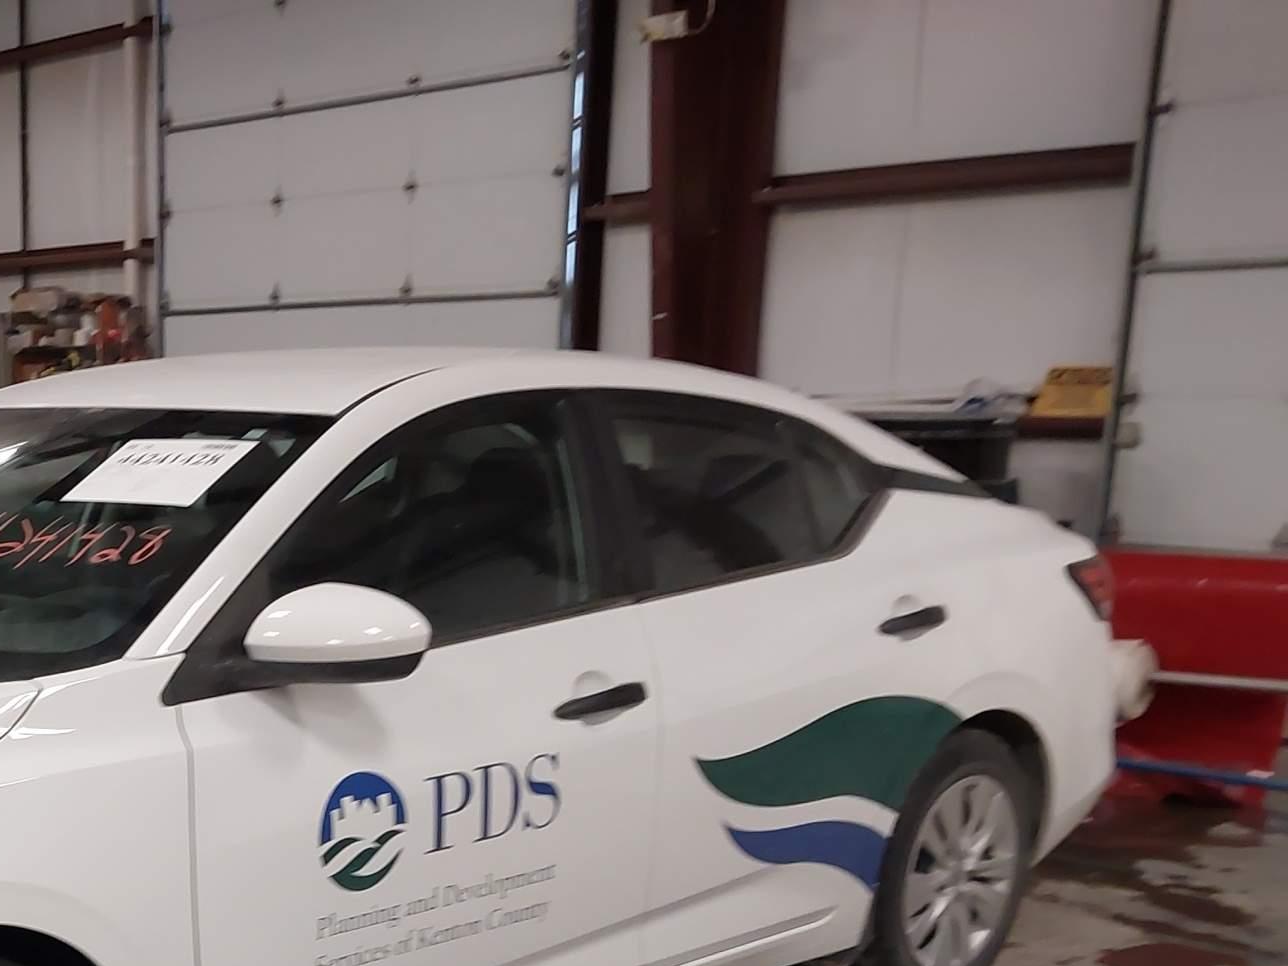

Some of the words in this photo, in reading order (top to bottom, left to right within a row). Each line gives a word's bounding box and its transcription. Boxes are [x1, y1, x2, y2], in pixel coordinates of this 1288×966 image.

[423, 752, 561, 855] PDS
[315, 904, 402, 940] Planning
[405, 886, 441, 917] and
[442, 864, 557, 908] Development
[485, 899, 552, 931] County
